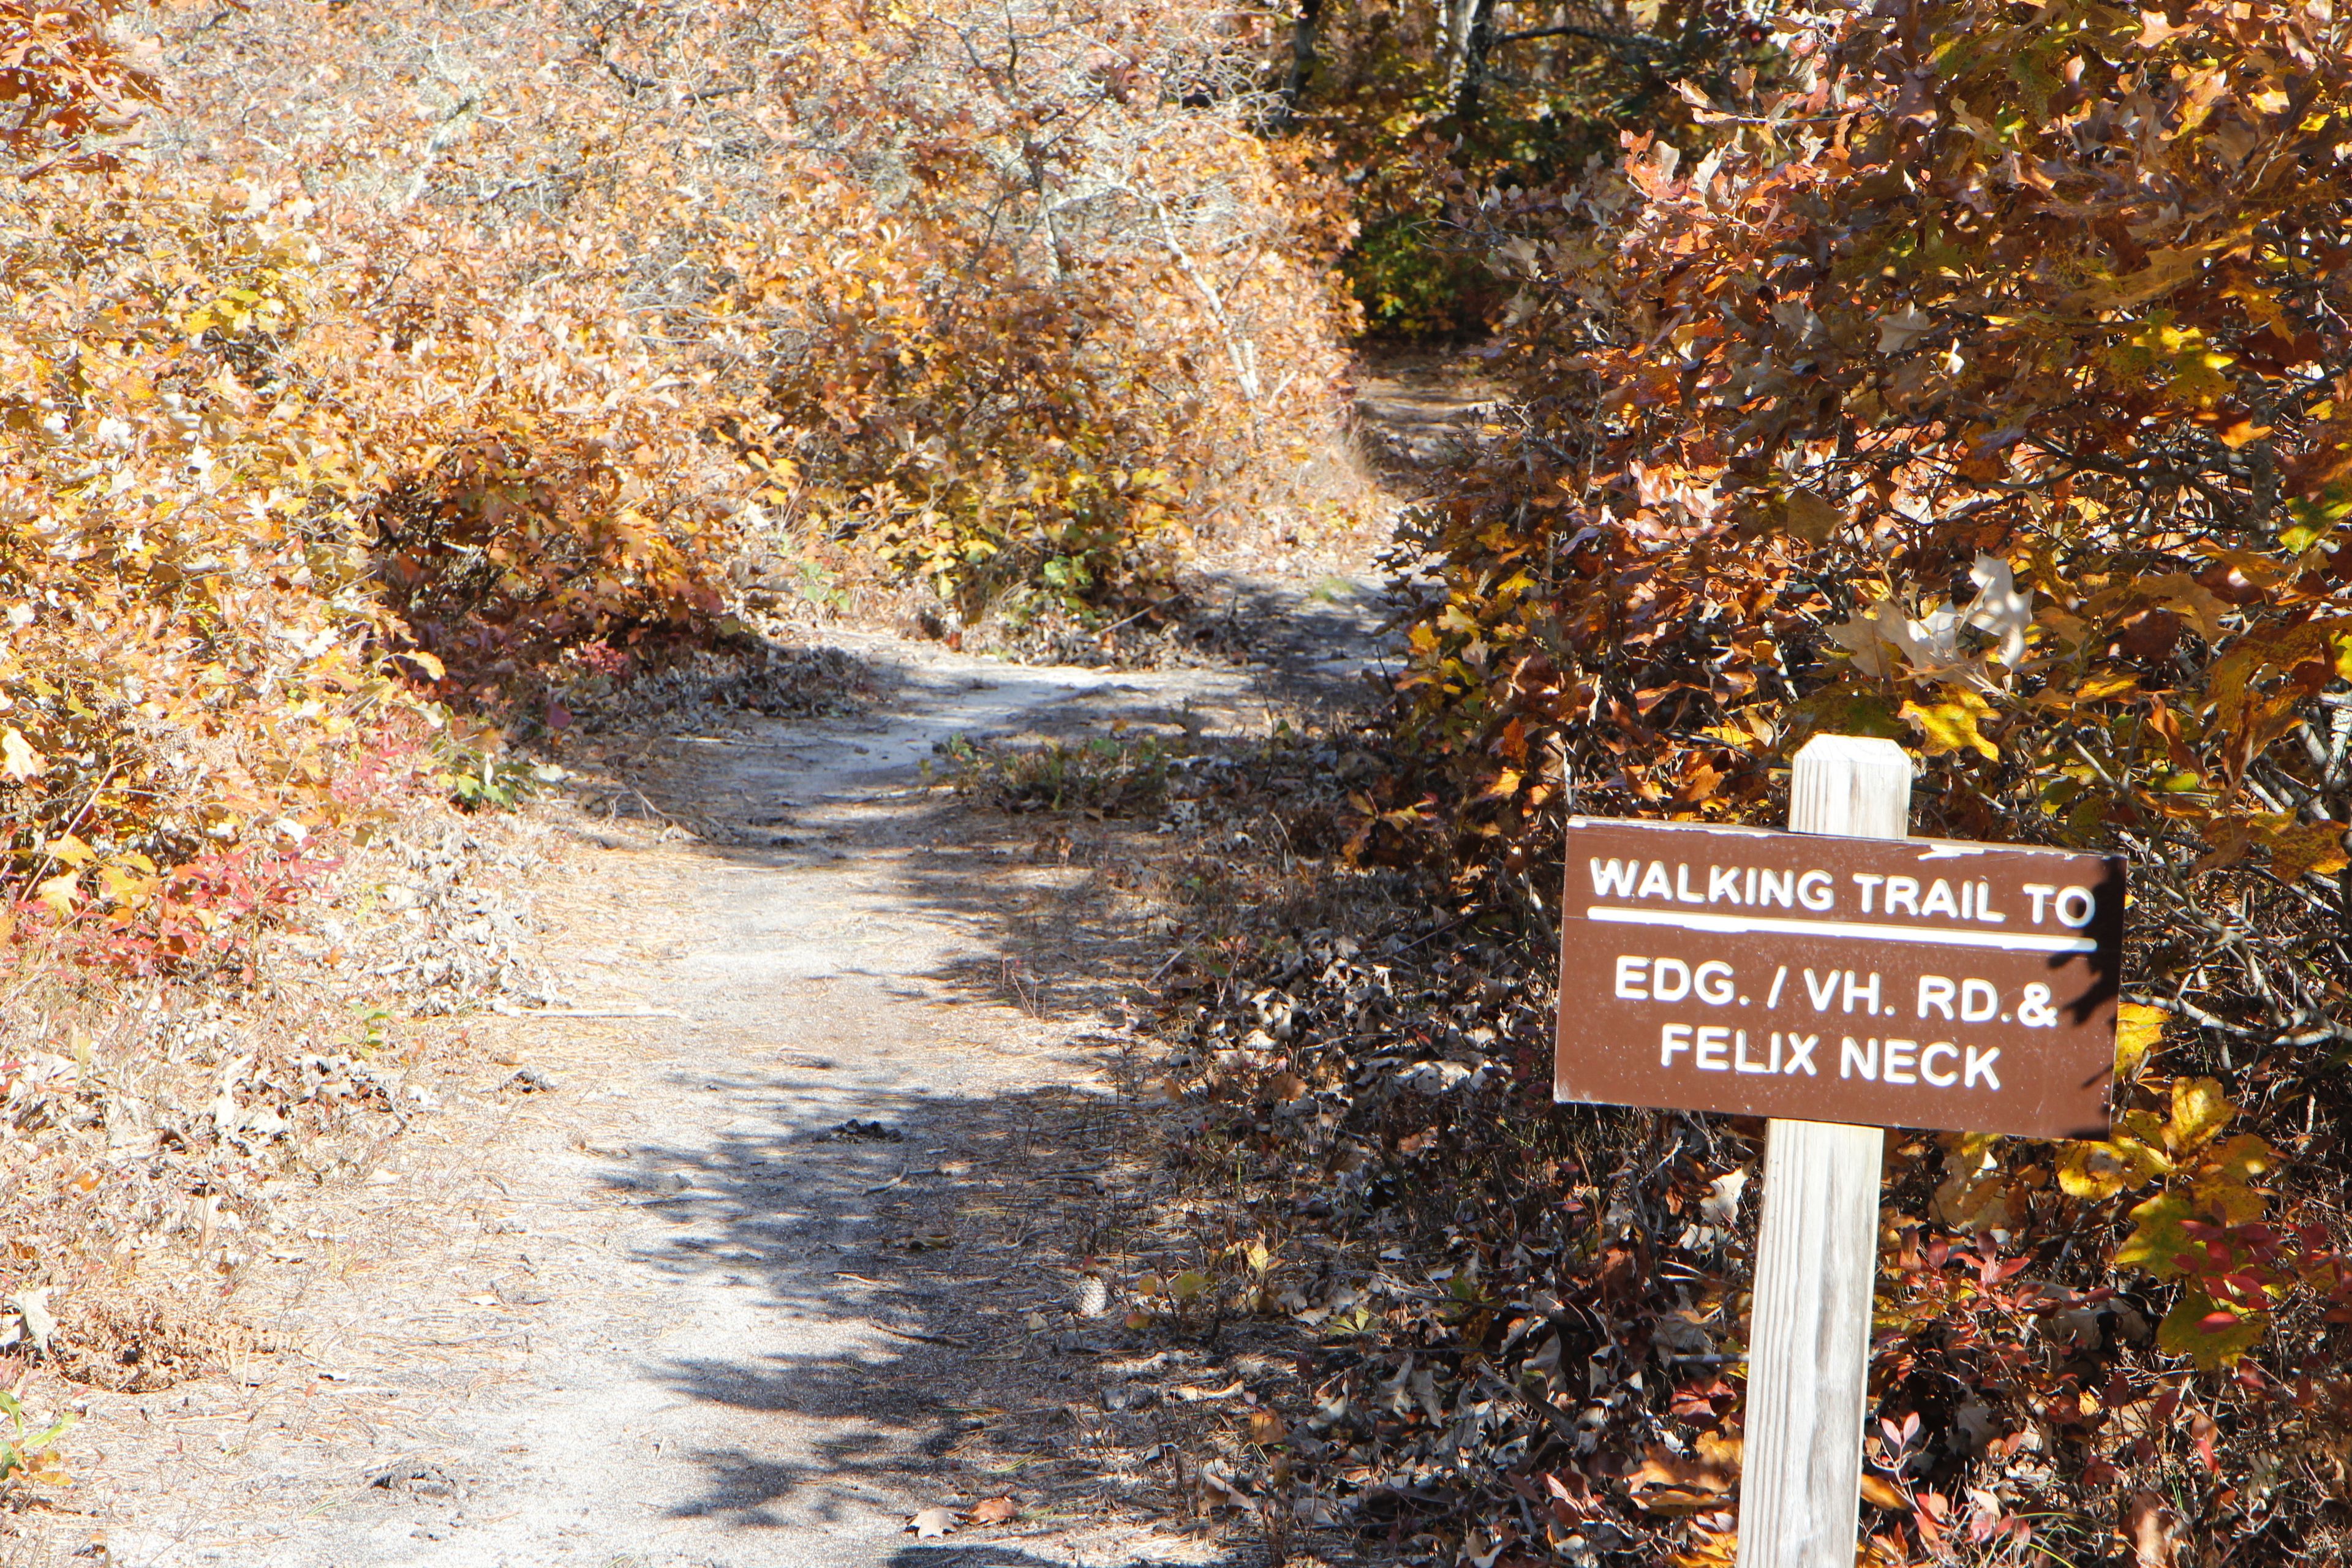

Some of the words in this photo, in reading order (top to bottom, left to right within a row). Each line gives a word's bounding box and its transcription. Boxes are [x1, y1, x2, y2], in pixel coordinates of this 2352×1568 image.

[1589, 857, 1834, 912] WALKING
[1852, 872, 2007, 924] TRAIL
[2022, 883, 2096, 928] TO
[1614, 955, 1751, 1006] EDG.
[1660, 1023, 1820, 1076] FELIX
[1839, 1036, 2002, 1091] NECK
